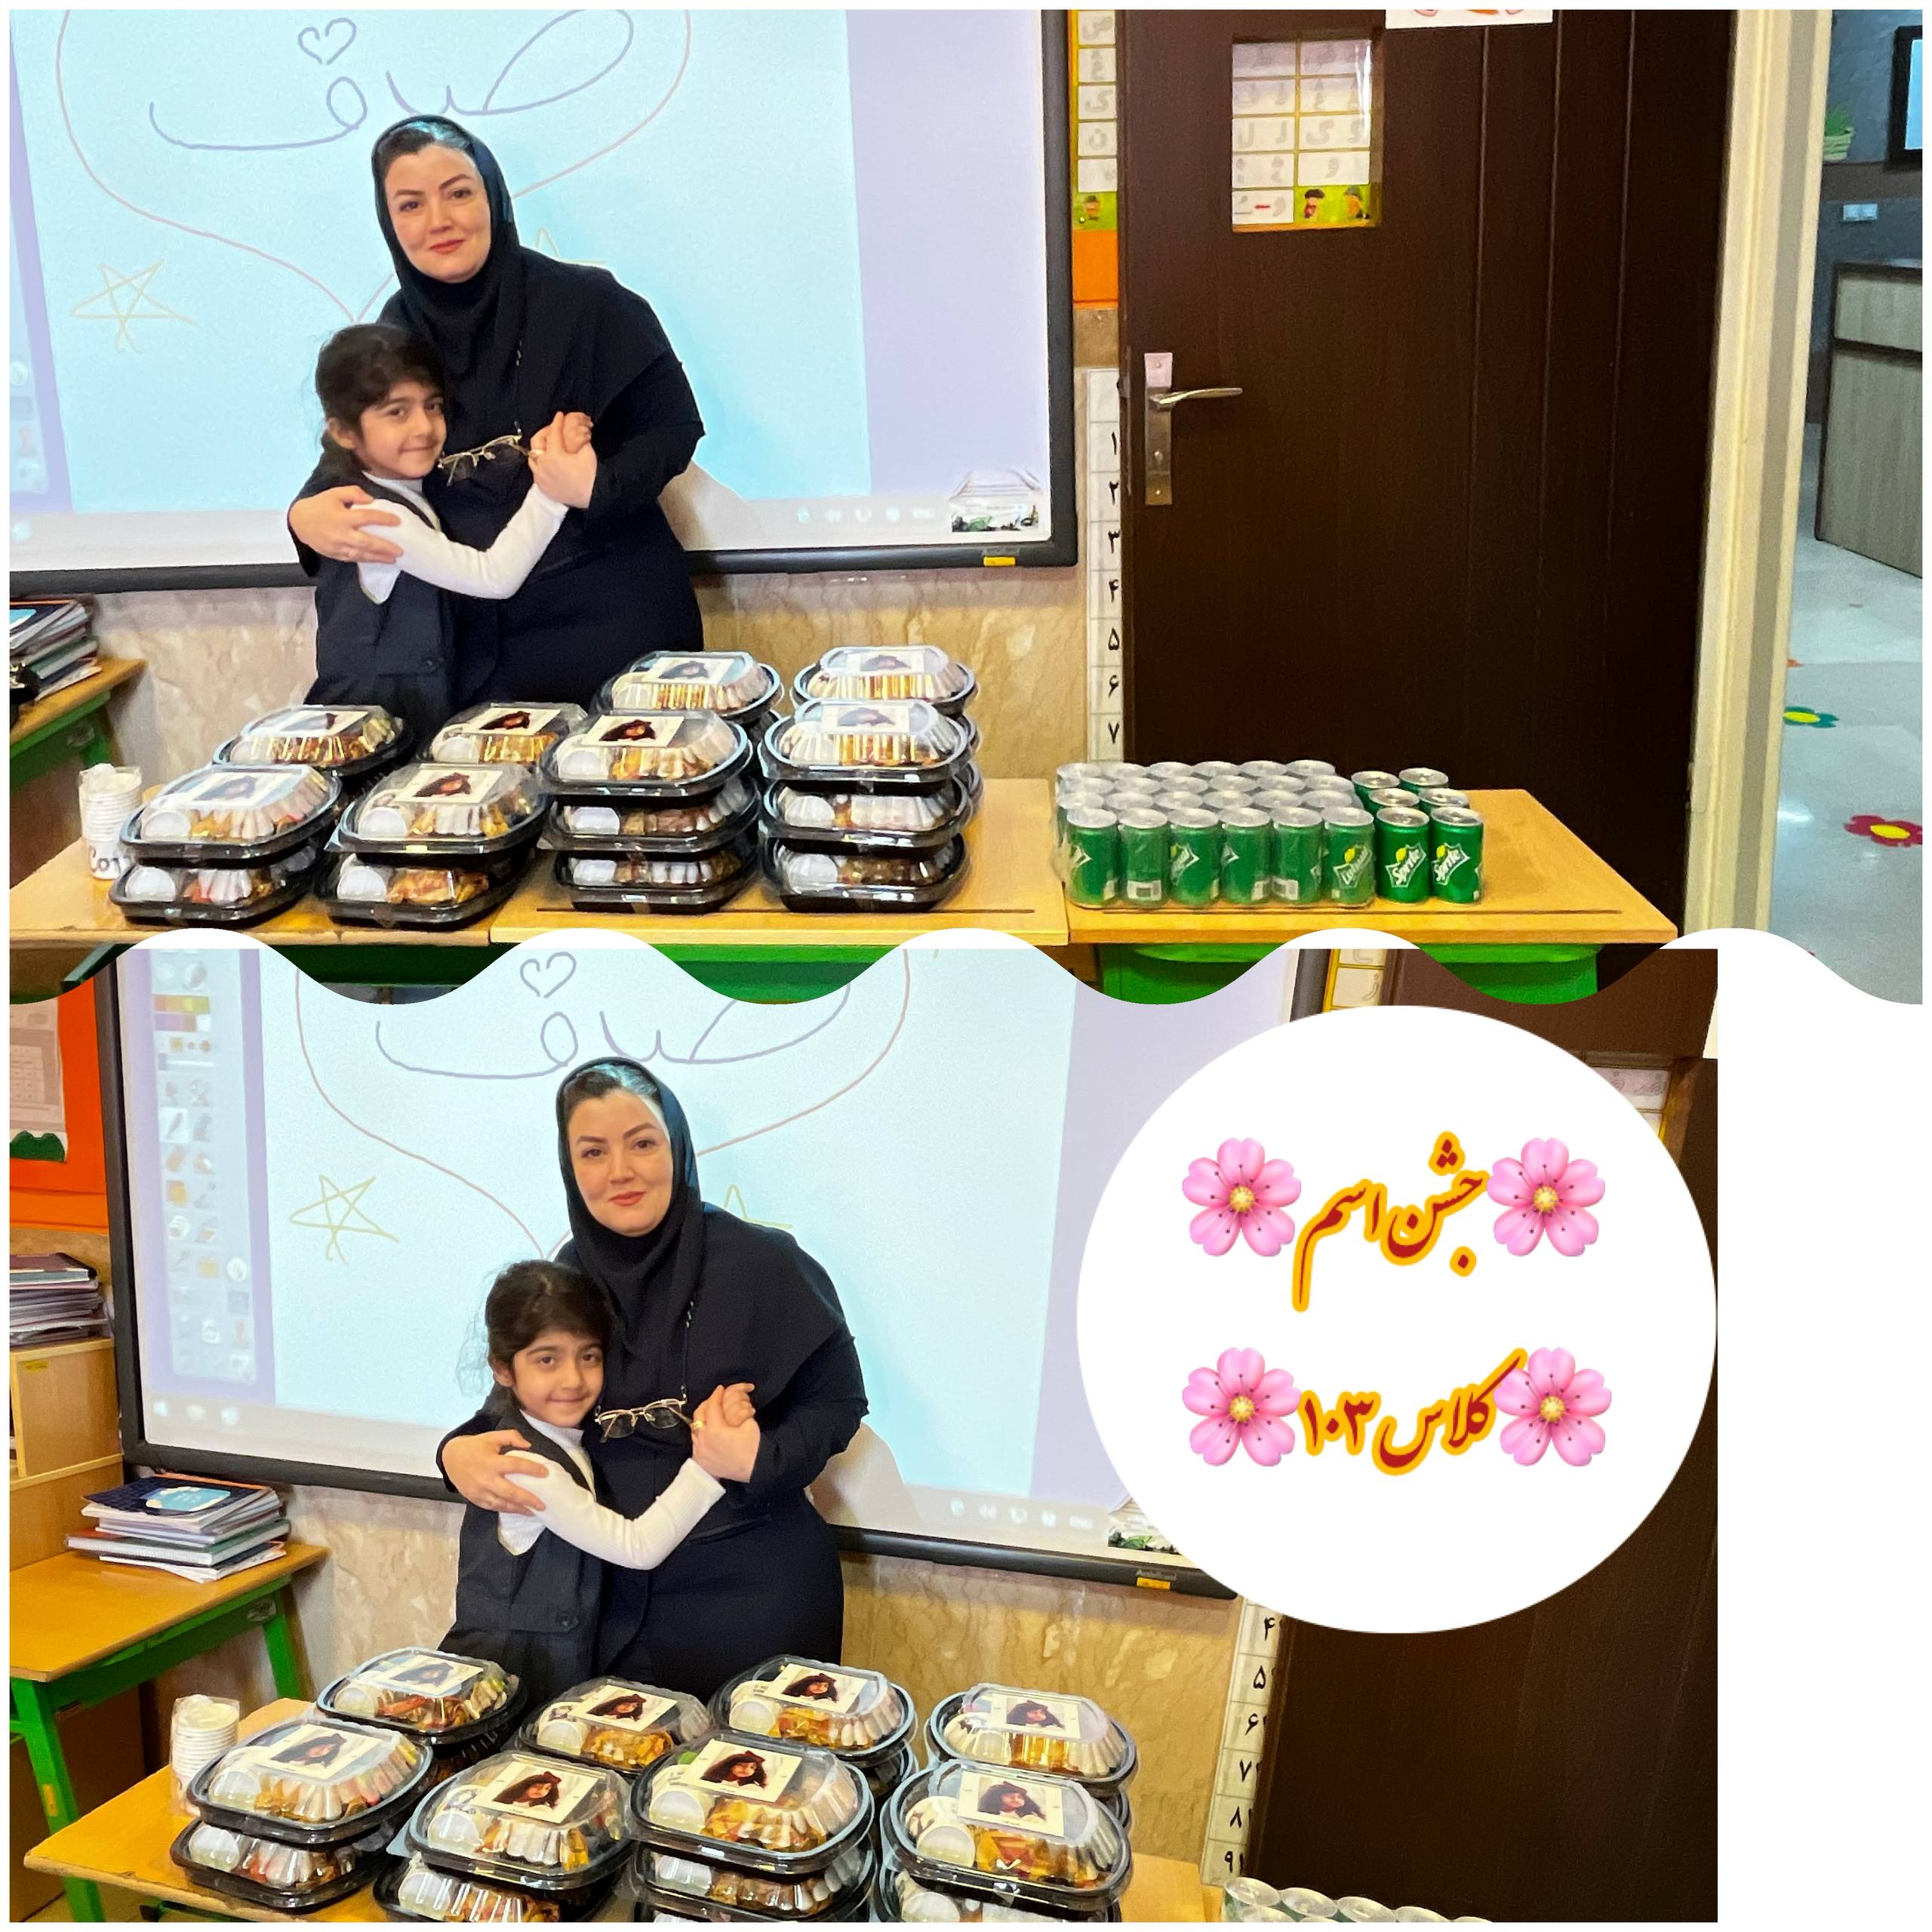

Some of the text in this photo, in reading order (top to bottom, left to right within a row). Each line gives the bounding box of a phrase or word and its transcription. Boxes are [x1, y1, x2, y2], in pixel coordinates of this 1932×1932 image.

[1109, 579, 1118, 603] ۴
[1108, 628, 1120, 651] ۵
[1108, 675, 1119, 698] ۶
[1108, 722, 1120, 744] ۷
[1263, 1617, 1275, 1641] ۴
[1253, 1665, 1266, 1689] ۵
[1245, 1712, 1259, 1736] ۶
[1239, 1759, 1252, 1782] ۷
[1229, 1806, 1242, 1828] ۸
[1224, 1850, 1233, 1873] ۹
